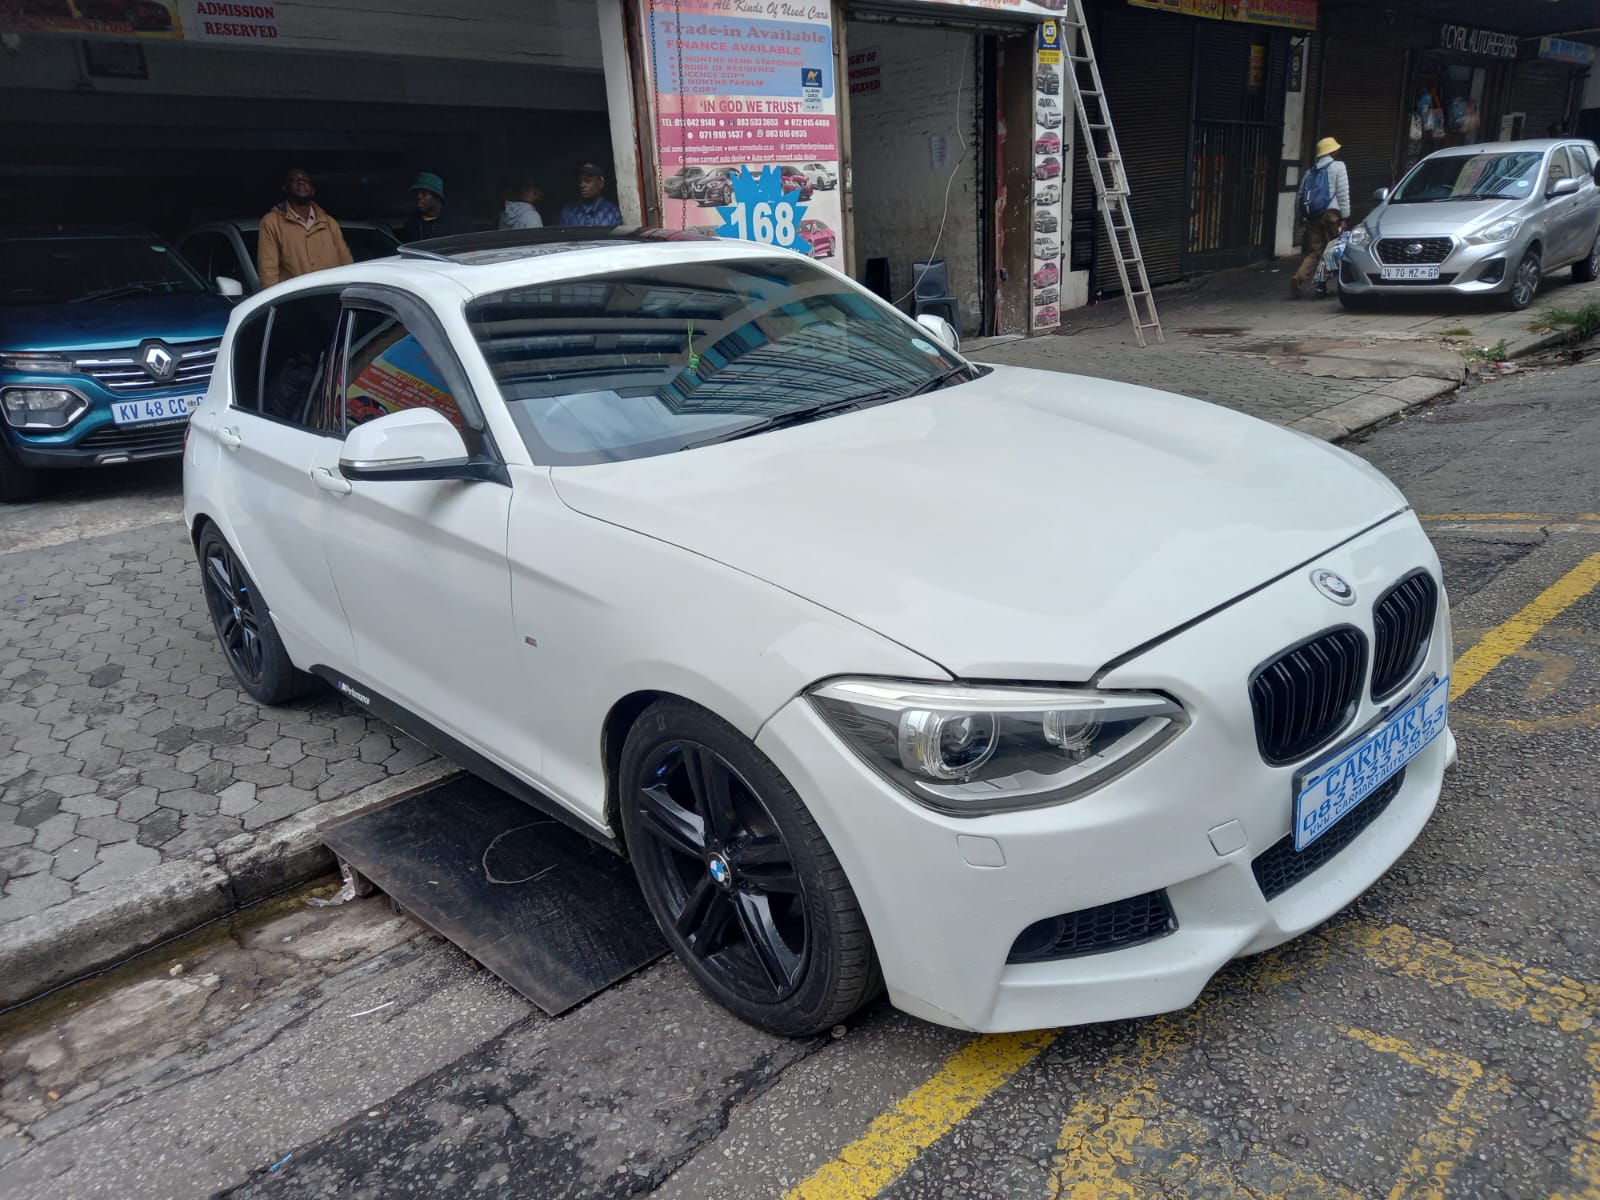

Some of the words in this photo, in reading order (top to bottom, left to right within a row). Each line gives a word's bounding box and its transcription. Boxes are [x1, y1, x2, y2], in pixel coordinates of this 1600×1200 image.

[197, 1, 275, 19] ADMISSION
[735, 0, 763, 13] Kinds
[767, 2, 779, 18] Of
[781, 3, 805, 17] Used
[808, 6, 829, 19] Cars
[204, 22, 278, 38] RESERVED
[661, 21, 742, 37] Trade-in
[747, 26, 826, 43] Available
[733, 43, 801, 56] AVAILABLE
[683, 63, 709, 71] ROOF
[684, 71, 719, 79] ICENCE
[719, 101, 743, 113] GOD
[746, 101, 763, 113] WE
[730, 202, 796, 246] 168
[1427, 268, 1439, 278] GP
[120, 403, 138, 421] KV
[145, 401, 163, 417] 48
[168, 398, 187, 414] CC
[1326, 697, 1430, 797] CARMART
[1303, 785, 1346, 831] 083
[1352, 747, 1392, 791] 533
[1397, 704, 1444, 754] 3653
